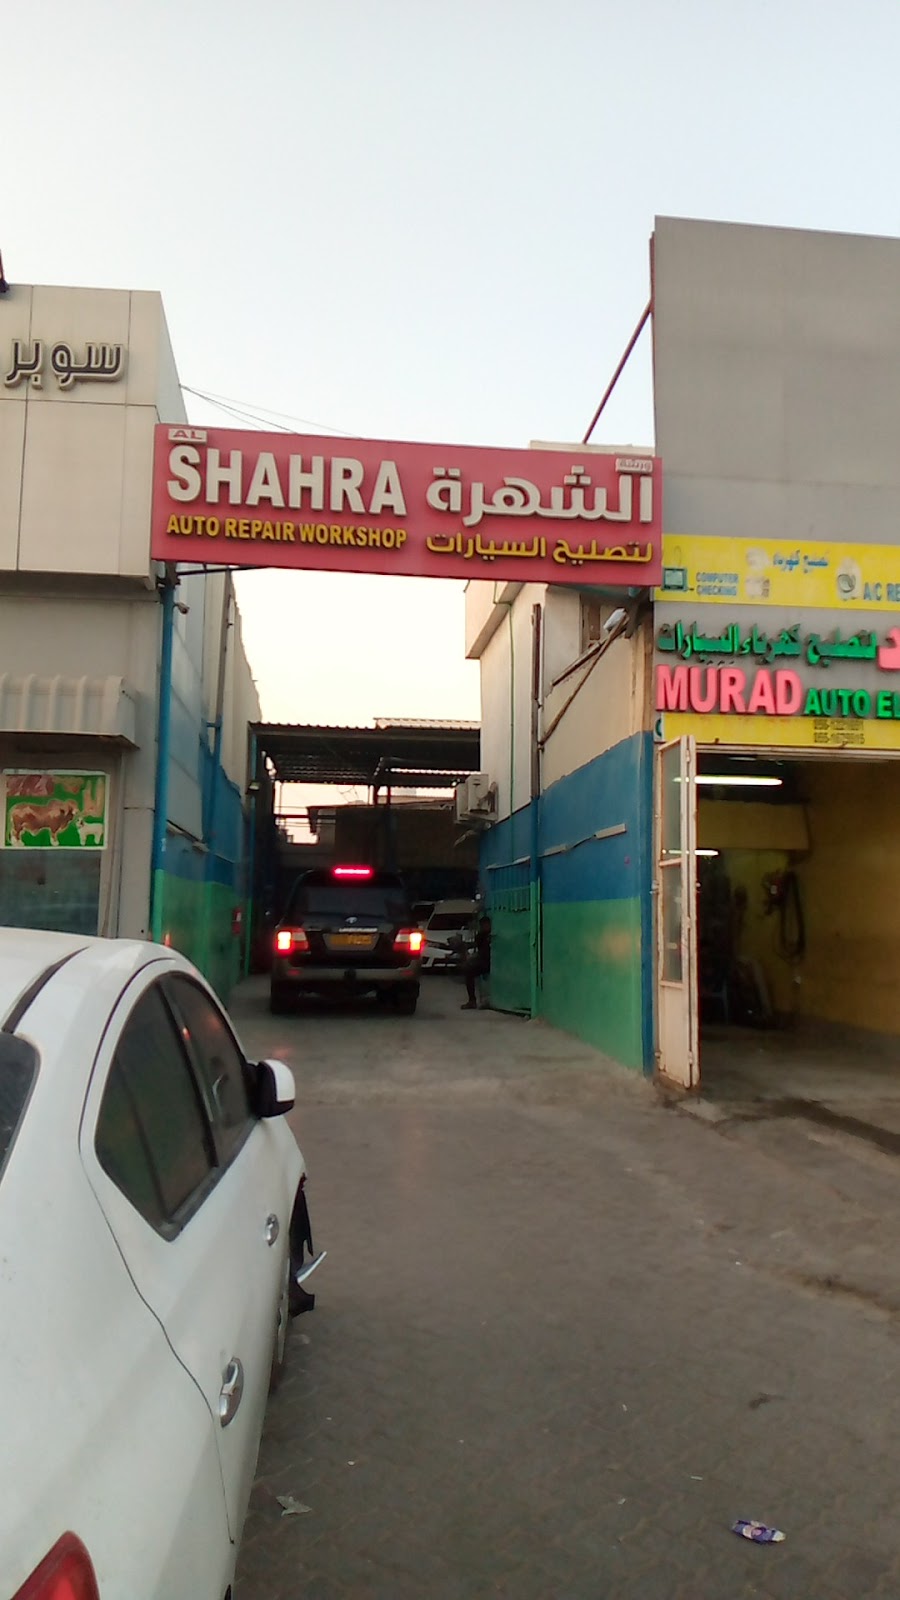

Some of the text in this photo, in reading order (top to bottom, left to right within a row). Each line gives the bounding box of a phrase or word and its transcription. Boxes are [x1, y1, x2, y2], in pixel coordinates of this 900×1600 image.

[4, 338, 126, 391] سوبر
[173, 429, 203, 440] AL
[166, 444, 408, 516] SHAHRA
[426, 464, 654, 527] الشهرة
[166, 514, 408, 549] AUTO REPAIR WORKSHOP
[425, 531, 654, 566] لتصليح السيارات
[655, 664, 804, 716] MURAD
[803, 688, 872, 718] AUTO
